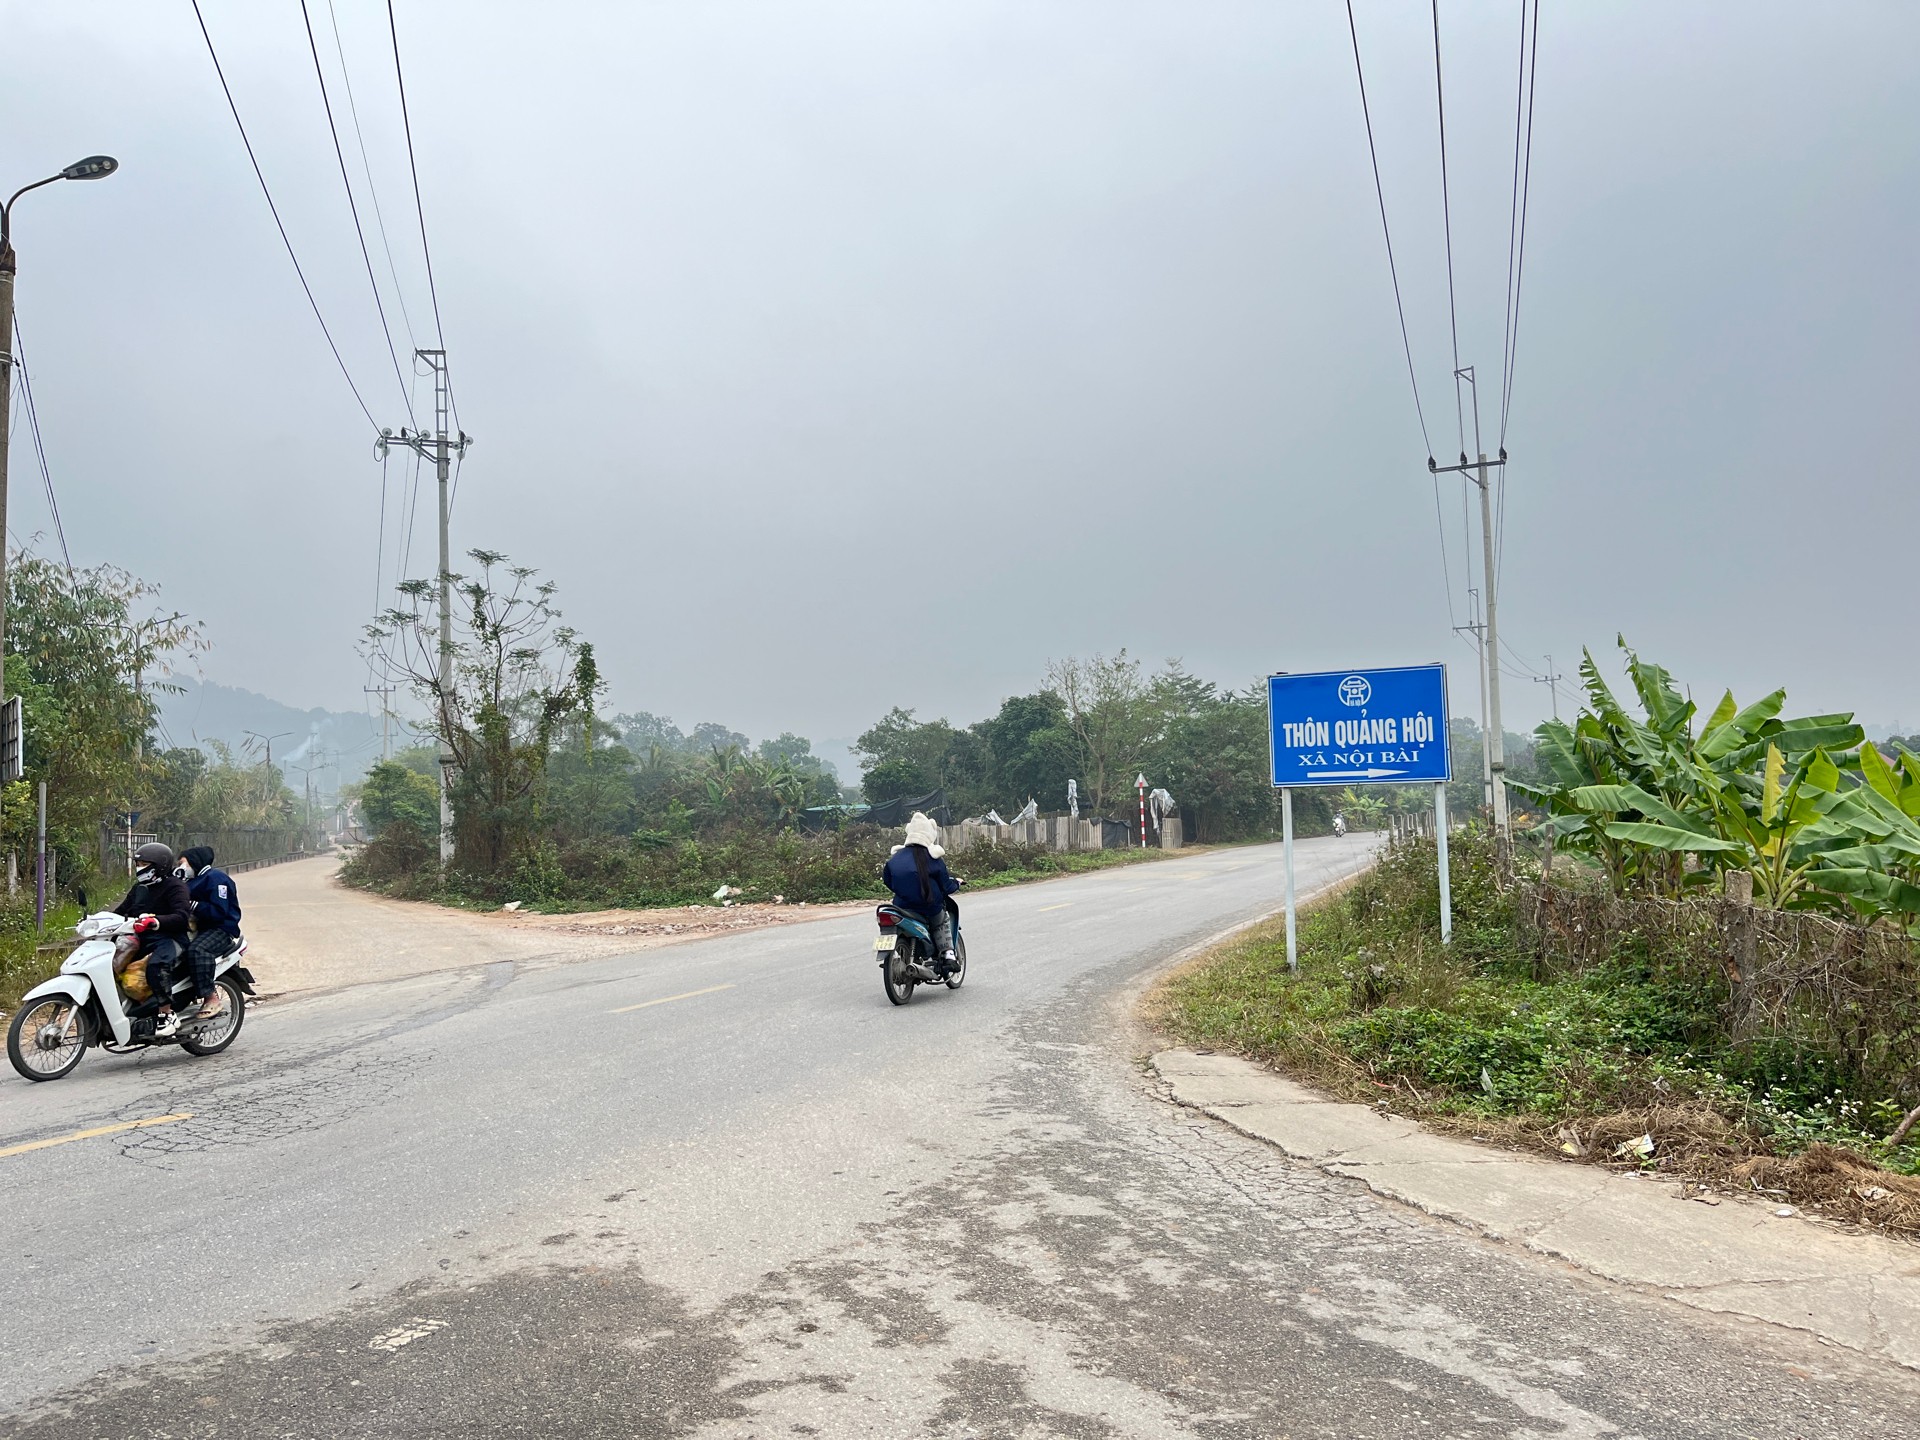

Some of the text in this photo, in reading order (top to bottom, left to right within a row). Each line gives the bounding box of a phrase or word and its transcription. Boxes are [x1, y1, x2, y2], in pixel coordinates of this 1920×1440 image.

[1282, 708, 1434, 749] THÔN QUẢNG HỘI
[1298, 748, 1420, 767] XÃ NỘI BÀI
